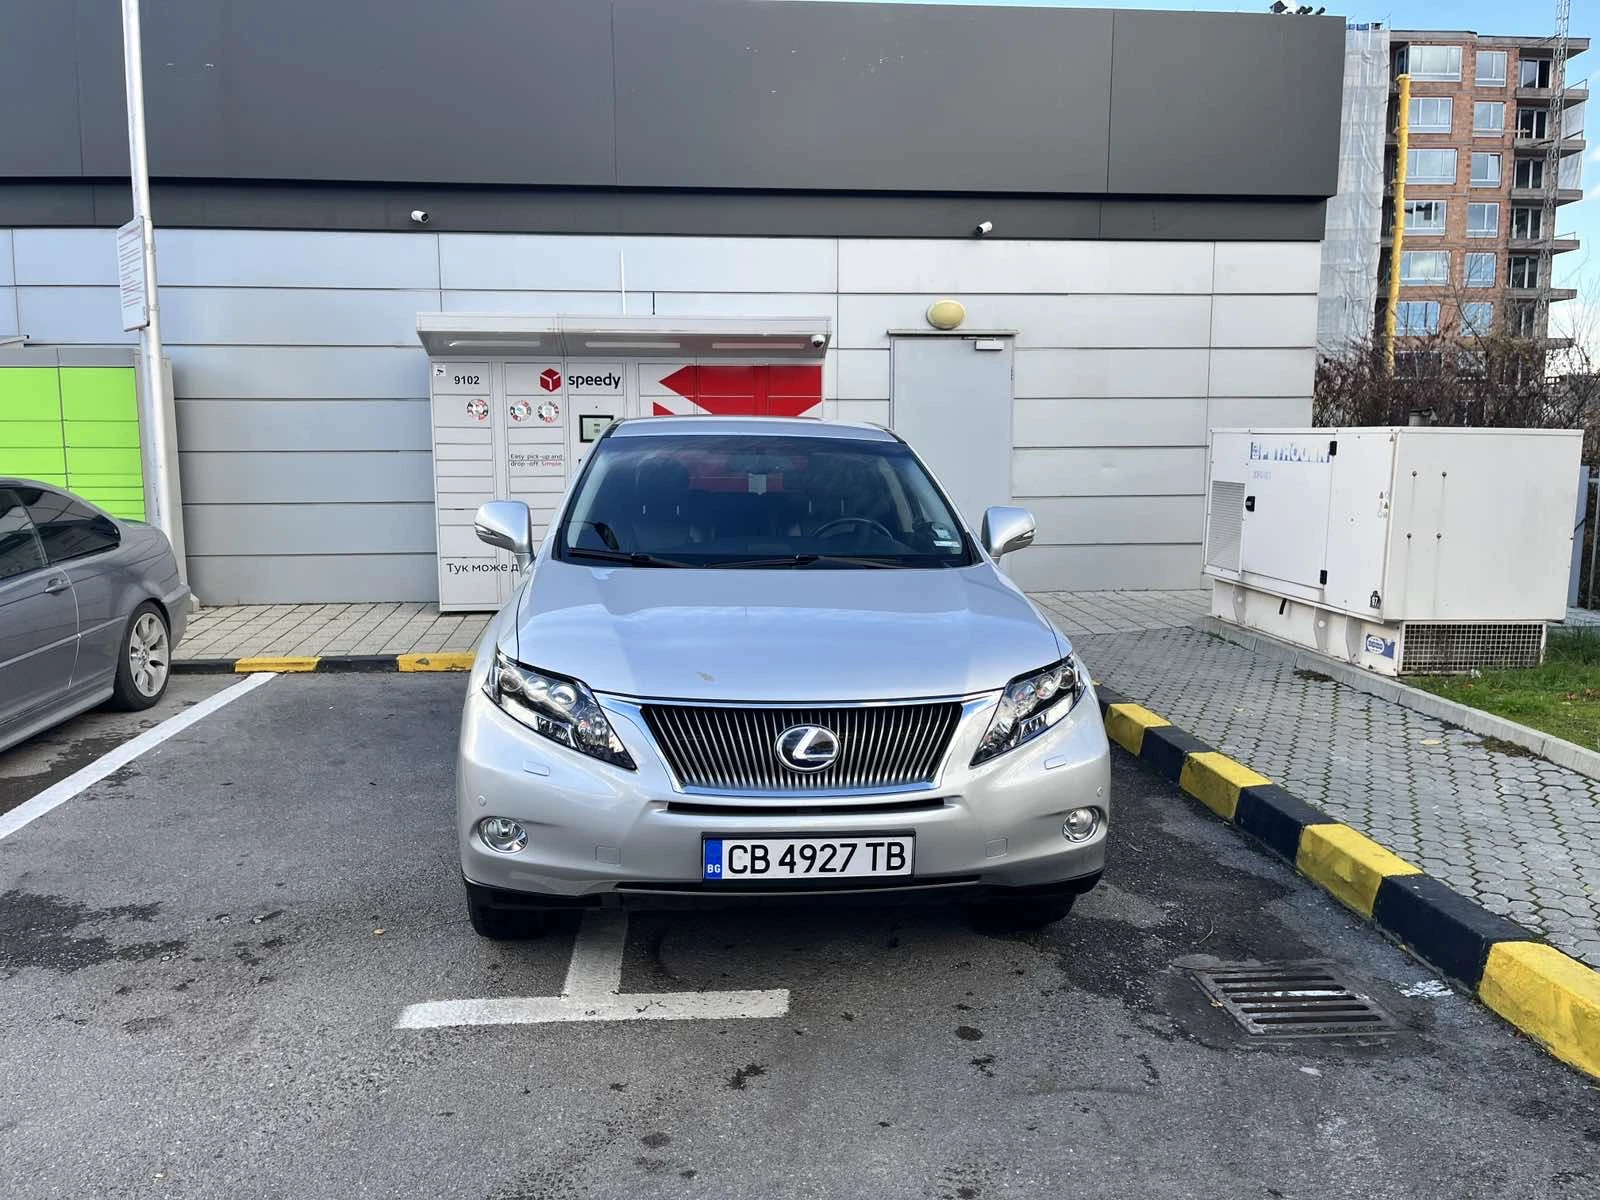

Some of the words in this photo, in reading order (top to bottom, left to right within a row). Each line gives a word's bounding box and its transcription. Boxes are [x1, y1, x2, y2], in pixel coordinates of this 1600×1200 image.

[454, 375, 480, 385] 9102
[568, 373, 621, 389] speedy
[446, 563, 469, 575] Тук
[472, 564, 508, 572] може
[728, 844, 771, 874] CB
[778, 842, 858, 874] 4927
[866, 841, 906, 872] TB
[707, 863, 721, 873] BG
